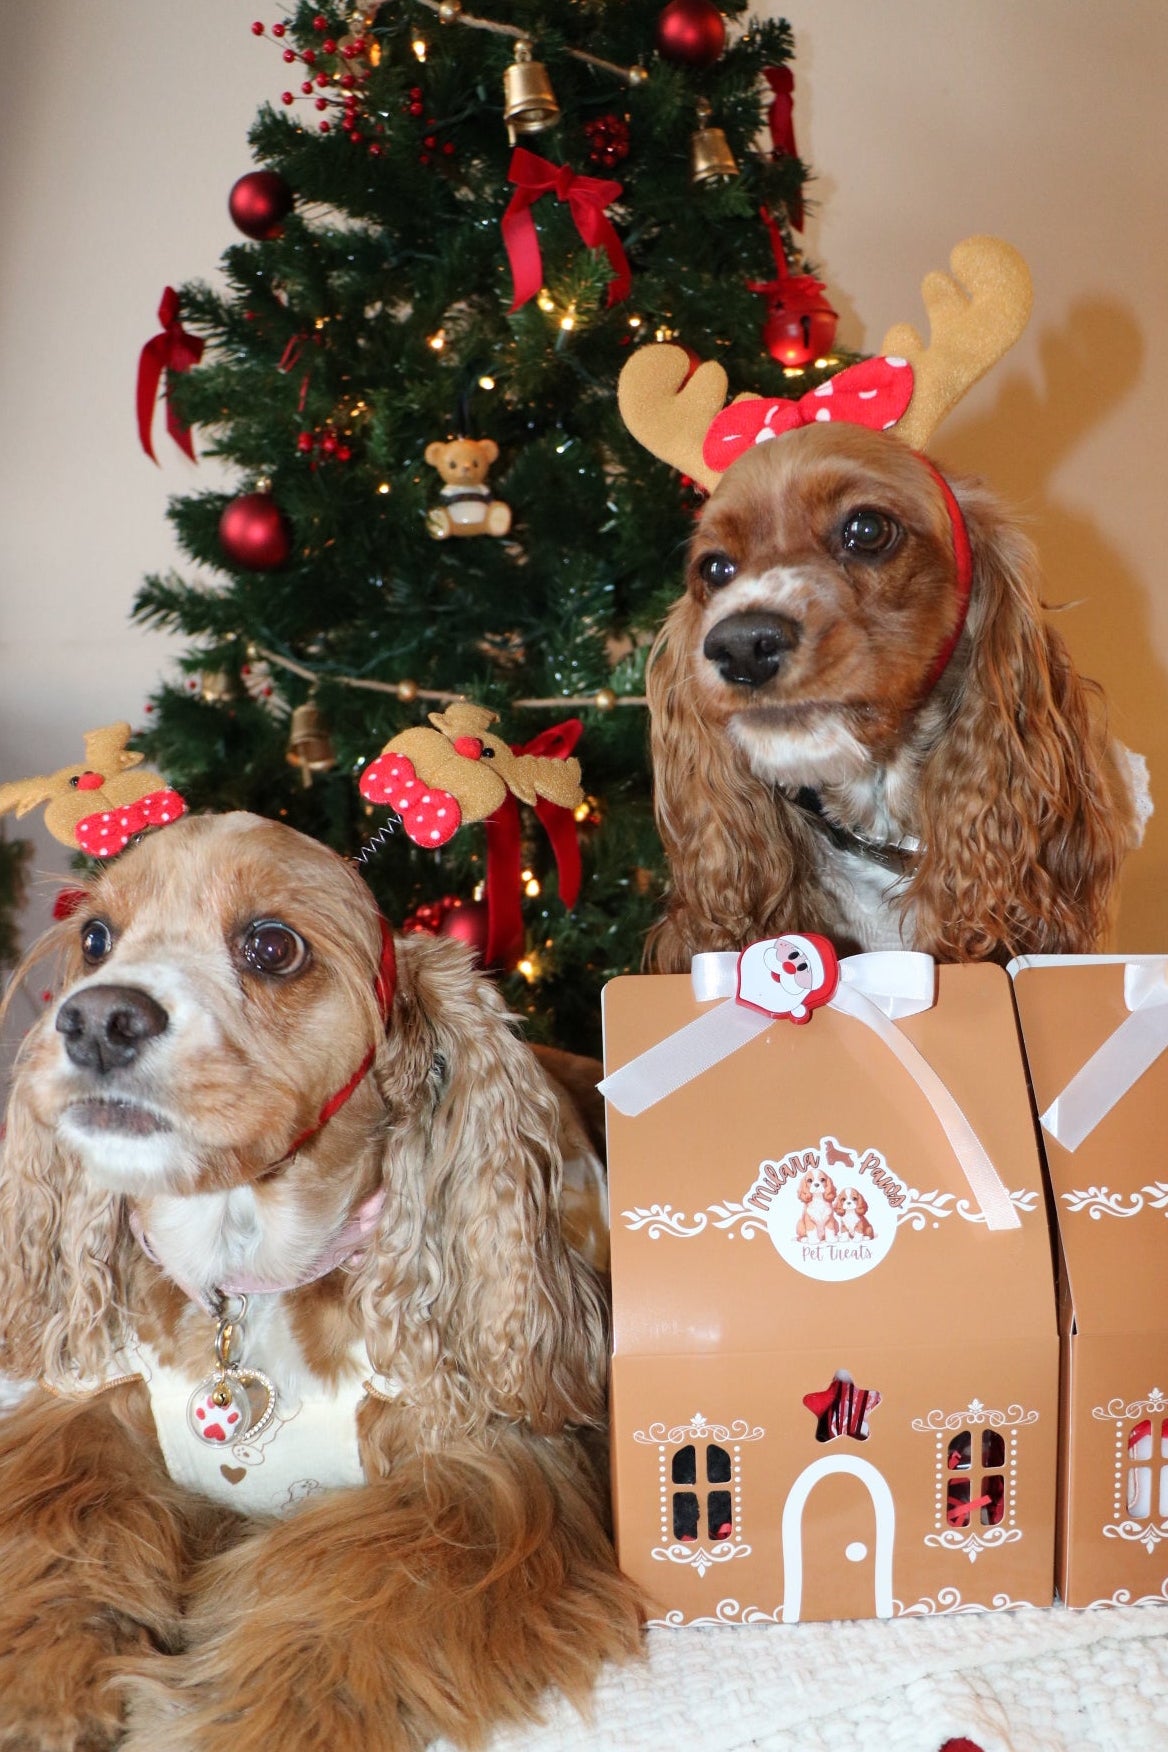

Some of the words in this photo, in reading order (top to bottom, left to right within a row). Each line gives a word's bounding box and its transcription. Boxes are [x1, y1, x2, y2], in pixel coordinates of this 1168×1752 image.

[748, 1152, 820, 1211] Milara
[858, 1153, 907, 1209] Paws
[802, 1245, 824, 1261] Pet
[827, 1244, 873, 1261] Treats
